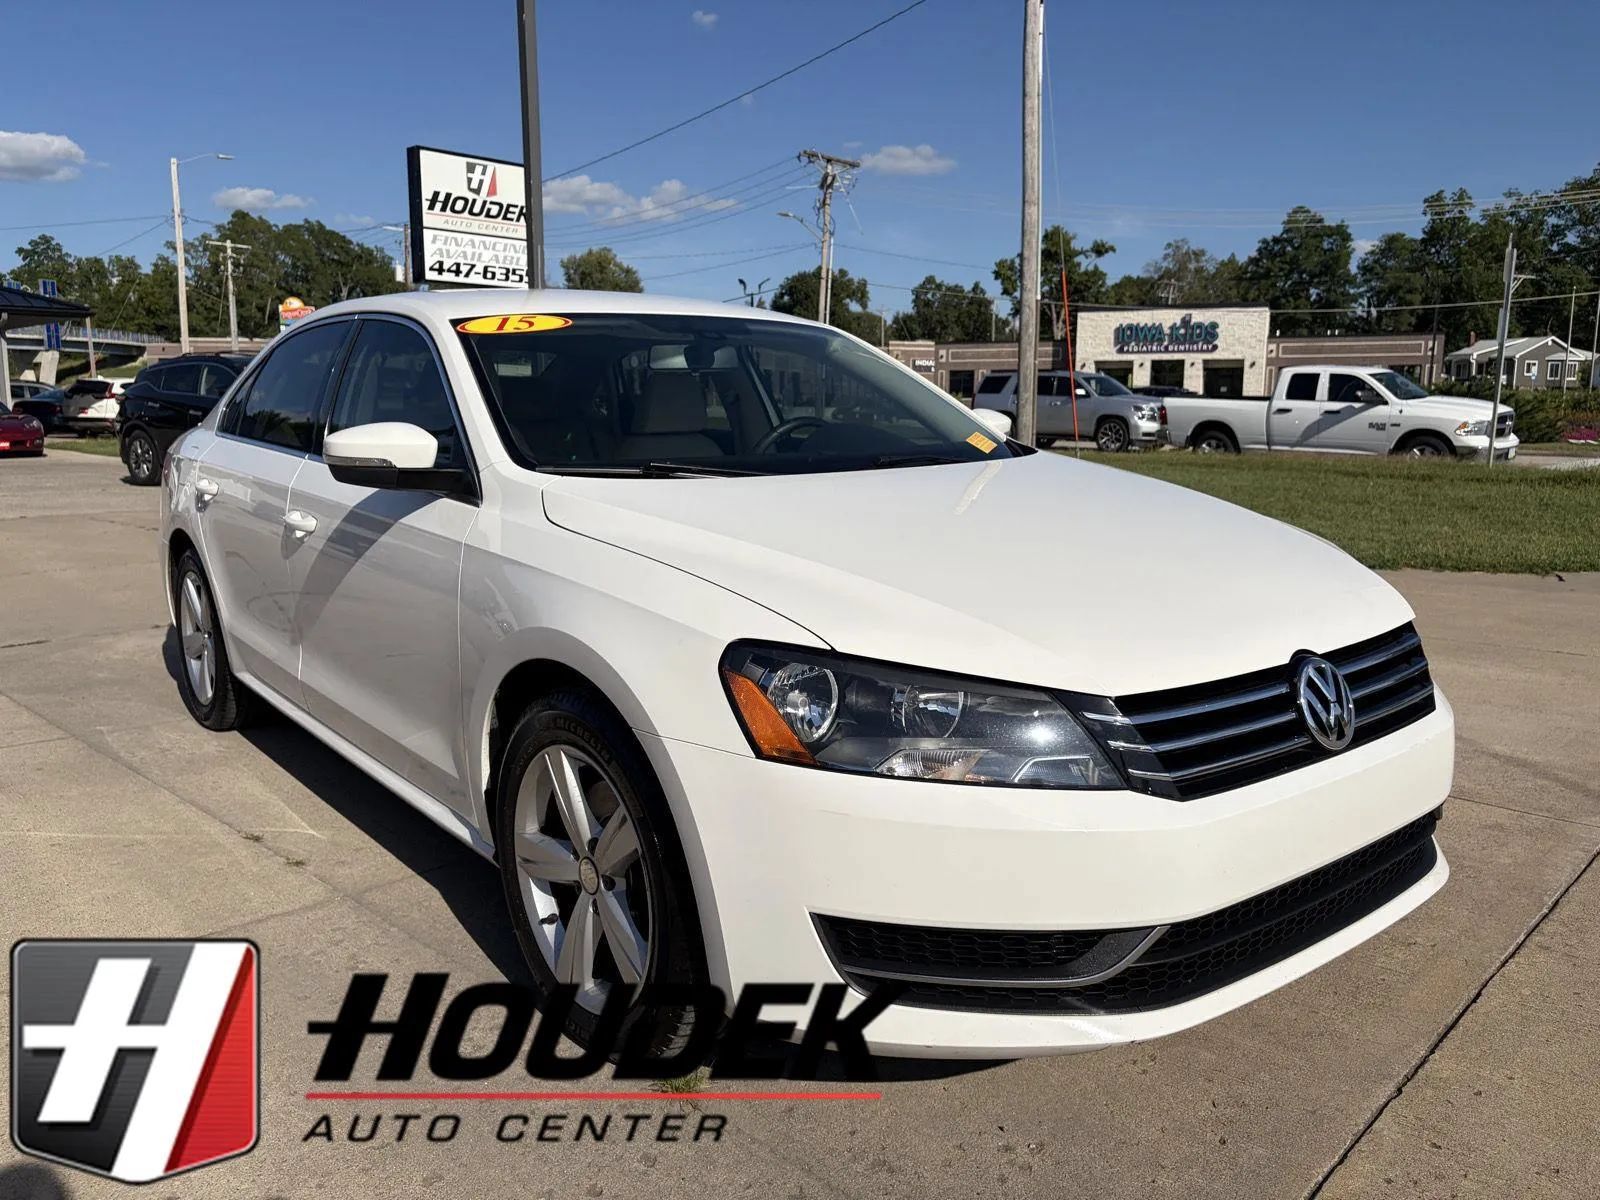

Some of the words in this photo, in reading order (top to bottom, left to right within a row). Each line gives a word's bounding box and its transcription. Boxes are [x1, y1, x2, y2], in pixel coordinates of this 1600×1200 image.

[425, 190, 527, 223] HOUDEK
[443, 219, 472, 228] AUTO
[477, 222, 519, 233] CENTER
[430, 247, 527, 267] AVAILABL
[428, 260, 528, 284] 447-635
[493, 316, 538, 331] 15
[1115, 322, 1166, 342] IOWA
[1123, 343, 1165, 352] PEDIATRIC
[1168, 343, 1213, 352] DENTISTRY
[556, 716, 610, 761] MICHELIN
